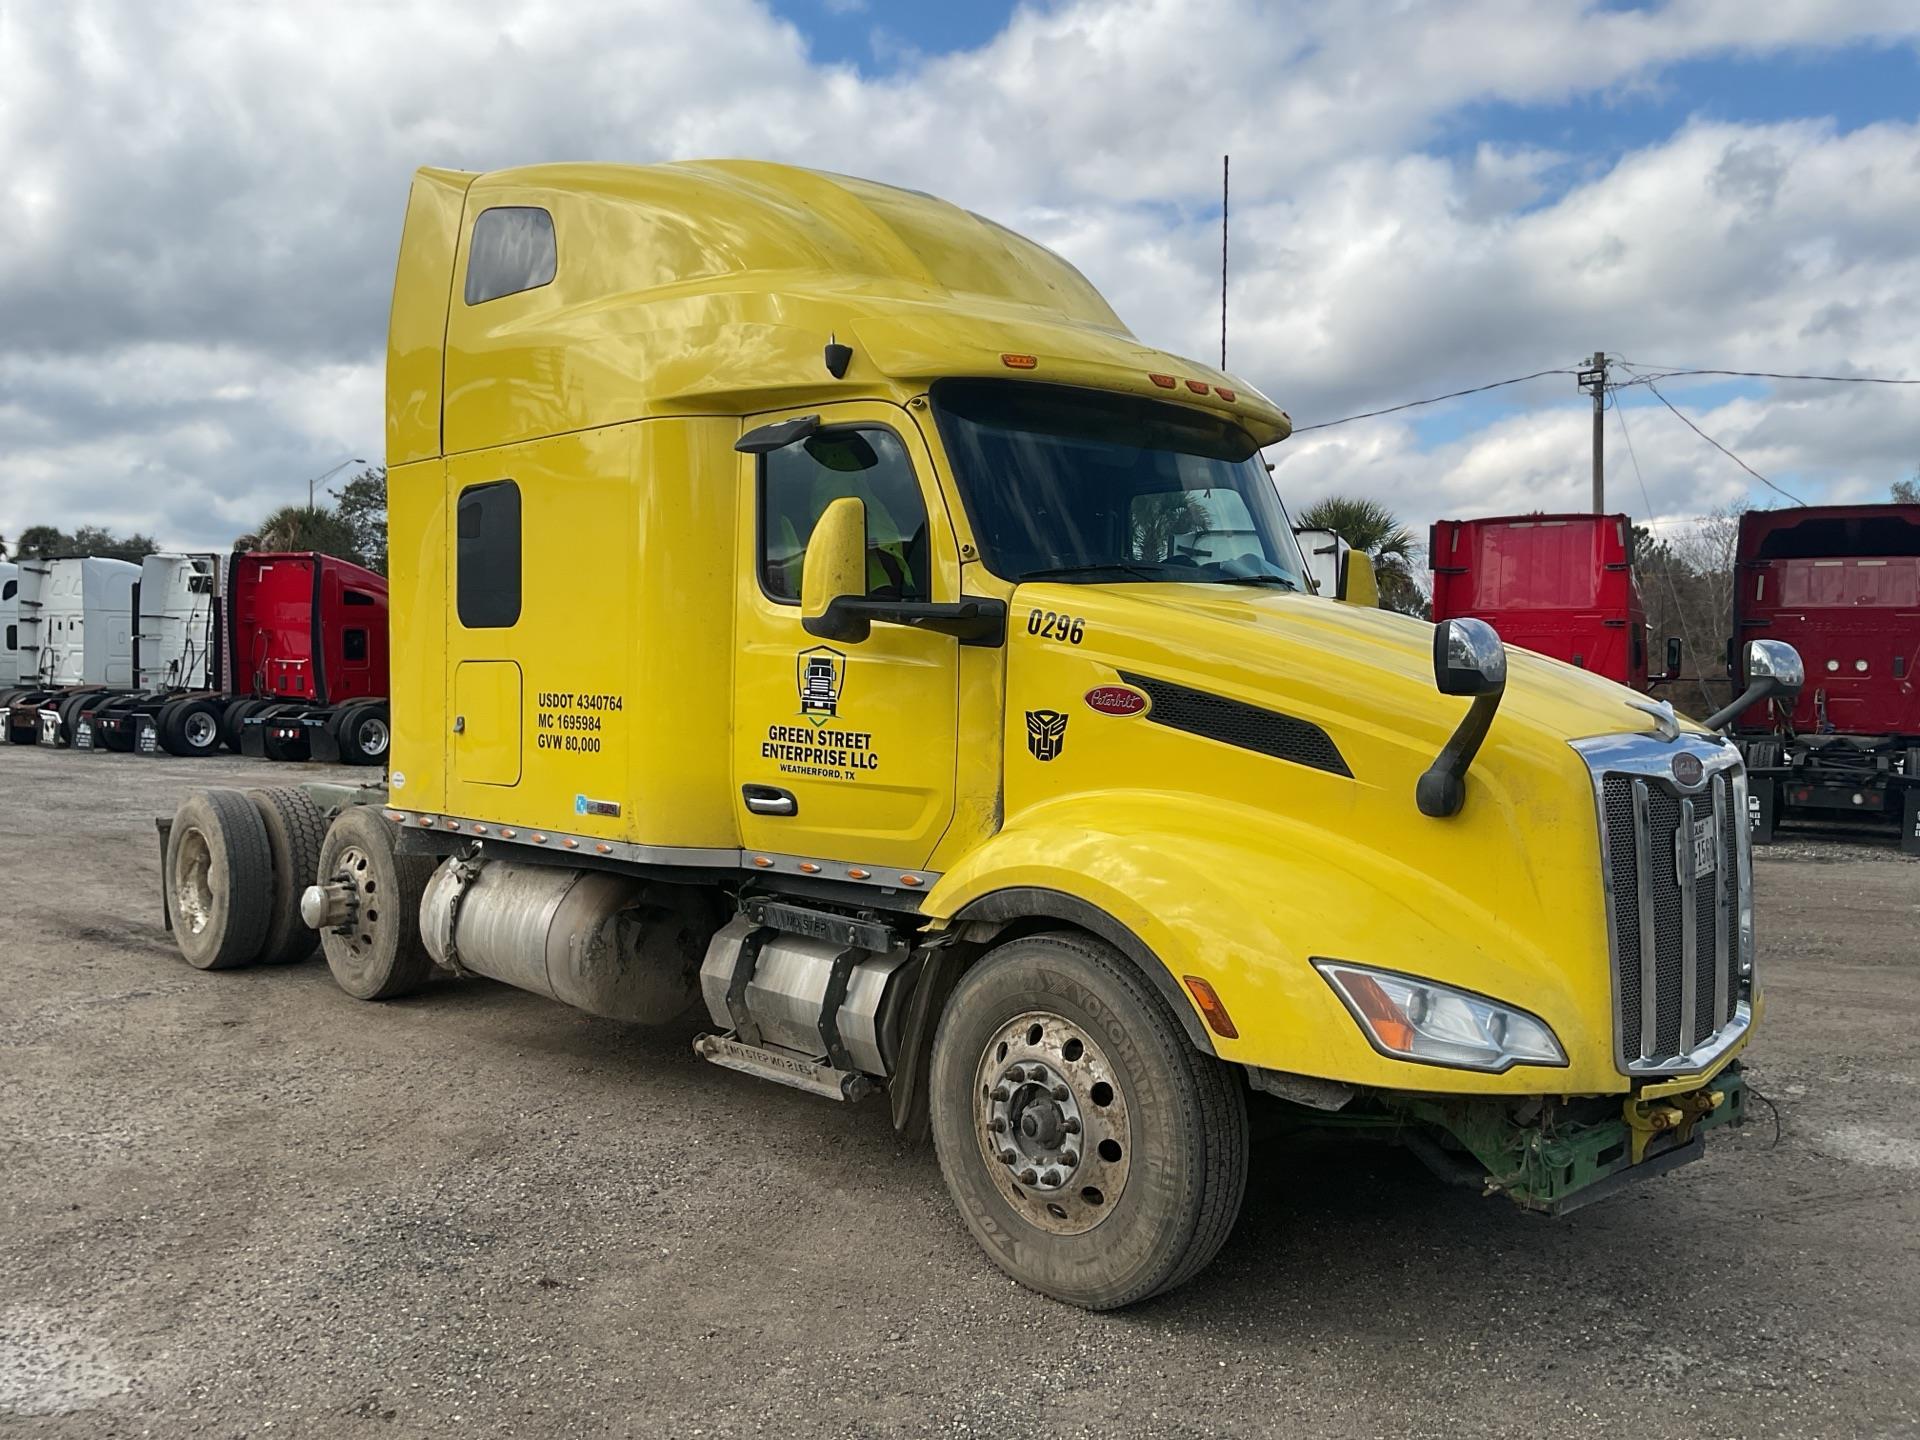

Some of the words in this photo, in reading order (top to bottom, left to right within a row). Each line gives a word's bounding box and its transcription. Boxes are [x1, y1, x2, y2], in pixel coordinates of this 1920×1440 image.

[1027, 608, 1085, 645] 0296
[538, 692, 574, 708] USDOT
[577, 694, 623, 711] 4340764
[1091, 690, 1141, 709] Peterbilt
[538, 713, 554, 729] MC
[557, 714, 601, 731] 1695984
[538, 733, 563, 749] GVW
[565, 735, 600, 755] 80,000
[769, 725, 814, 745] GREEN
[817, 729, 872, 750] STREET
[762, 742, 847, 767] ENTERPRISE
[850, 751, 878, 770] LLC
[780, 763, 843, 780] WEATHERFORD,
[845, 770, 855, 780] TX
[803, 919, 827, 933] STEP
